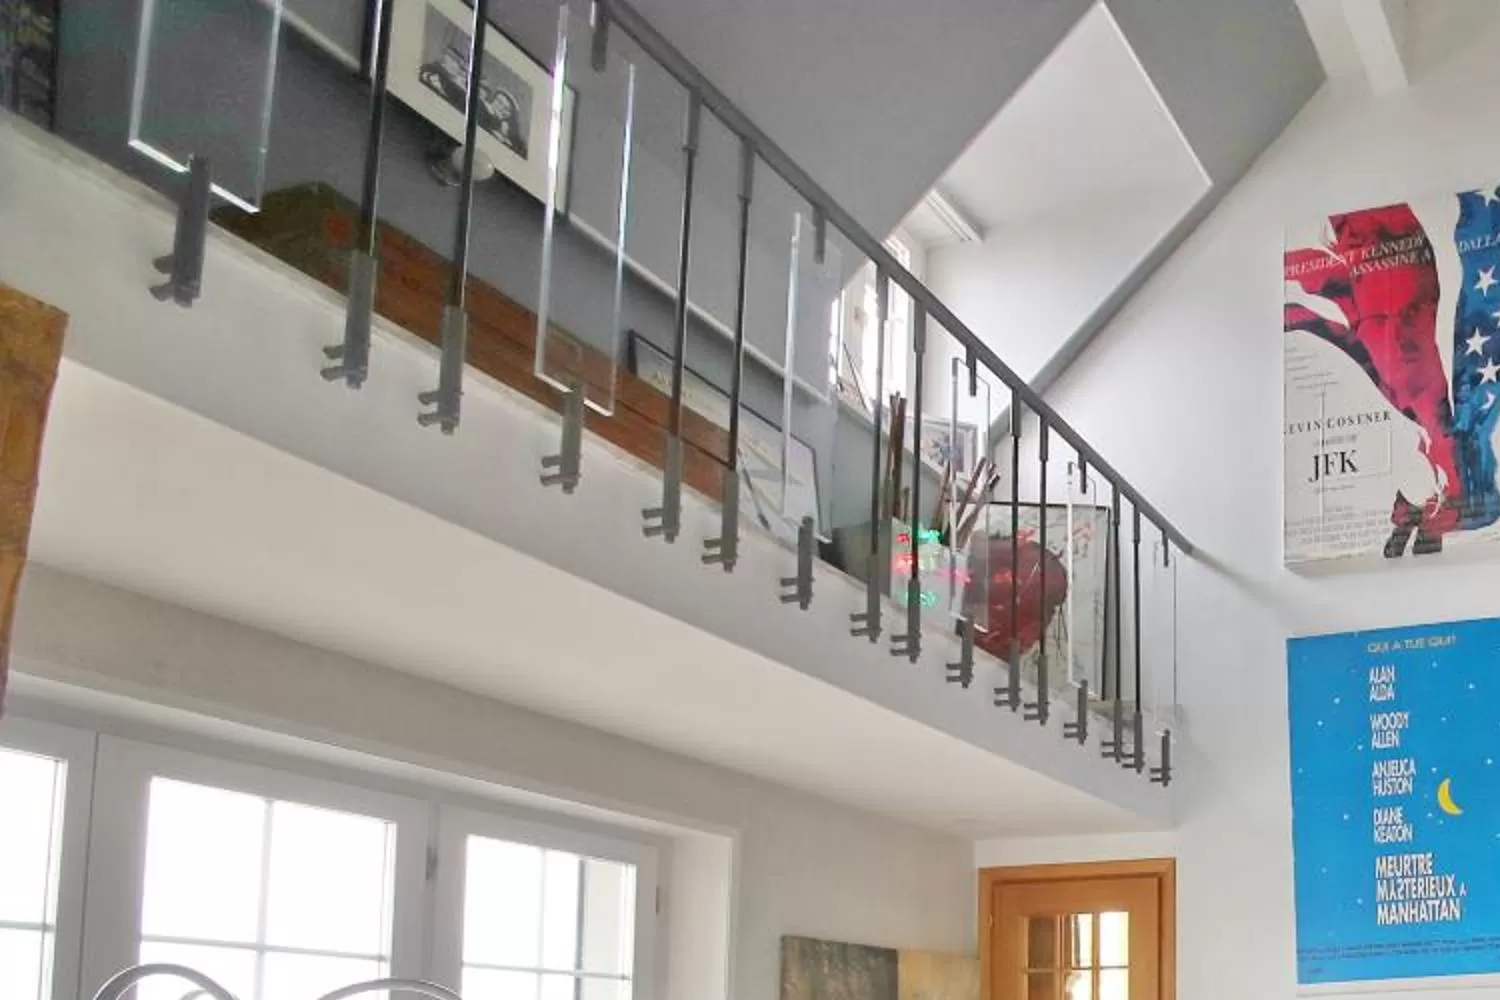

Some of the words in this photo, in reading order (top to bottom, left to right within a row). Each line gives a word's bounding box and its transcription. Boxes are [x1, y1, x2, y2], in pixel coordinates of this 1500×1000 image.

[1284, 420, 1321, 435] EVIN
[1308, 449, 1360, 482] JFK
[1370, 665, 1395, 684] ALAN
[1370, 683, 1395, 702] ALDA
[1370, 712, 1408, 731] WOODY
[1372, 730, 1399, 750] ALLEN
[1373, 776, 1412, 796] HUSTON
[1374, 806, 1403, 825] DIANE
[1374, 823, 1412, 843] KEATON
[1376, 852, 1433, 879] MEURTRE
[1377, 898, 1461, 925] MANHATTAN
